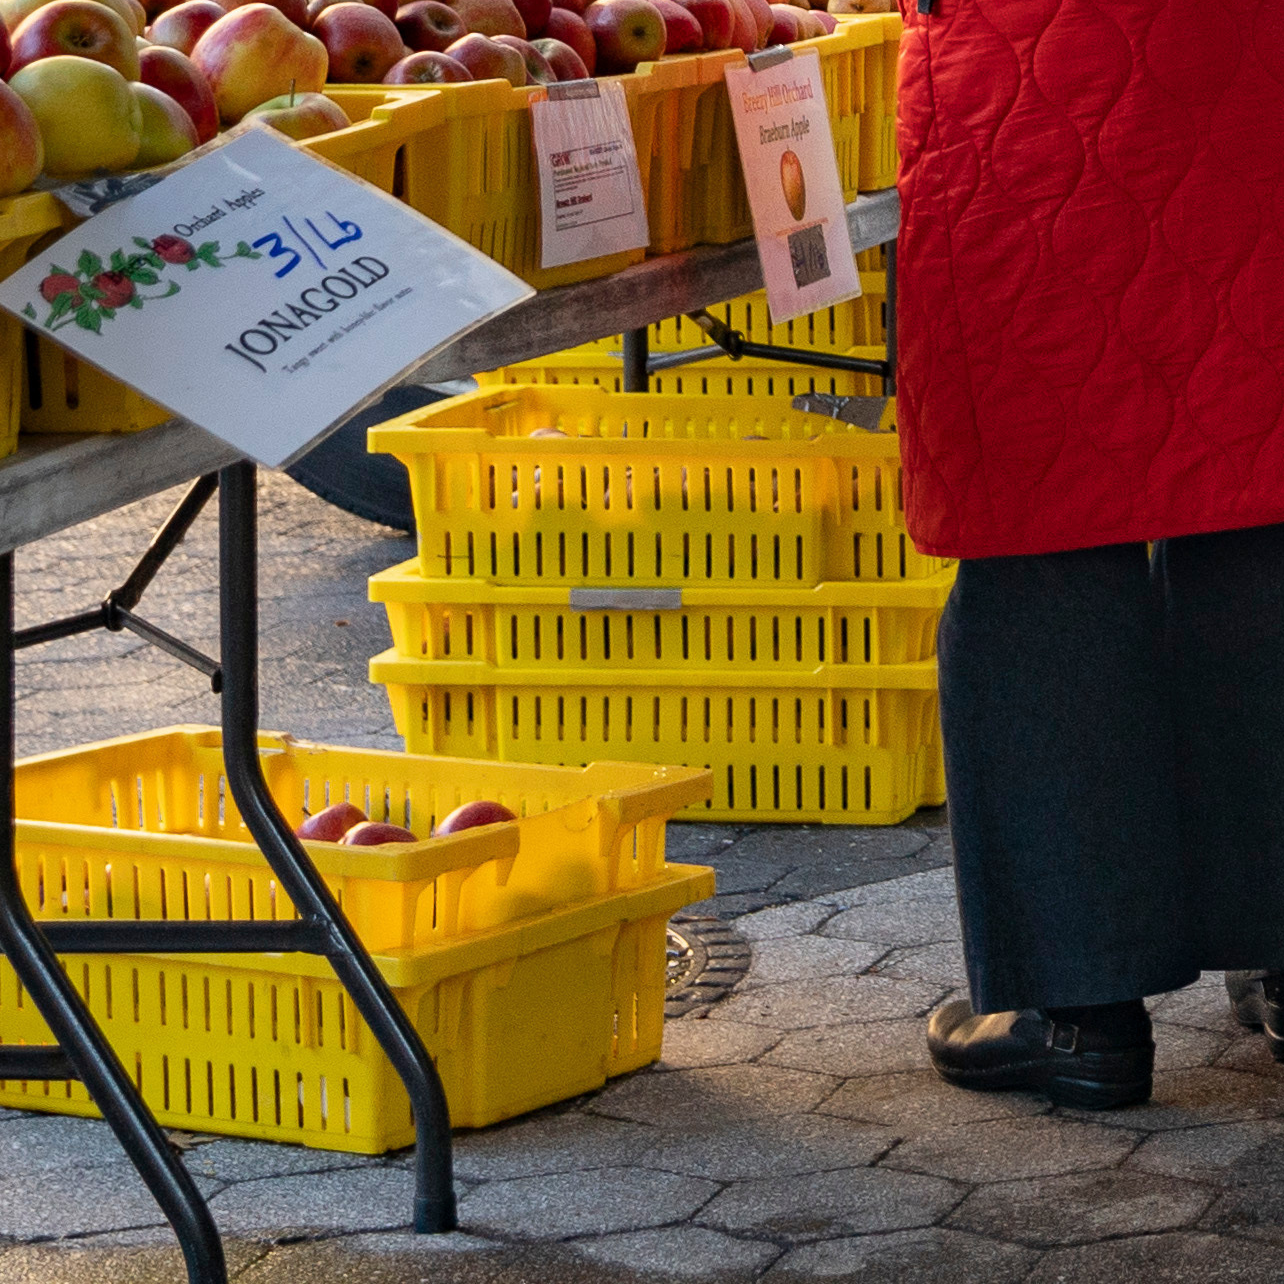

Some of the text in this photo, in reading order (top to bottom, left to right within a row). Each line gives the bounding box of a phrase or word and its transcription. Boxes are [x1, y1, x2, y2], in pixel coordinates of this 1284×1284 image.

[766, 84, 783, 109] Hill
[782, 77, 814, 104] Orchard
[758, 114, 811, 145] Braeburn Apple
[173, 204, 227, 238] Orchard
[223, 187, 267, 212] Apples
[224, 255, 390, 374] JONAGOLD
